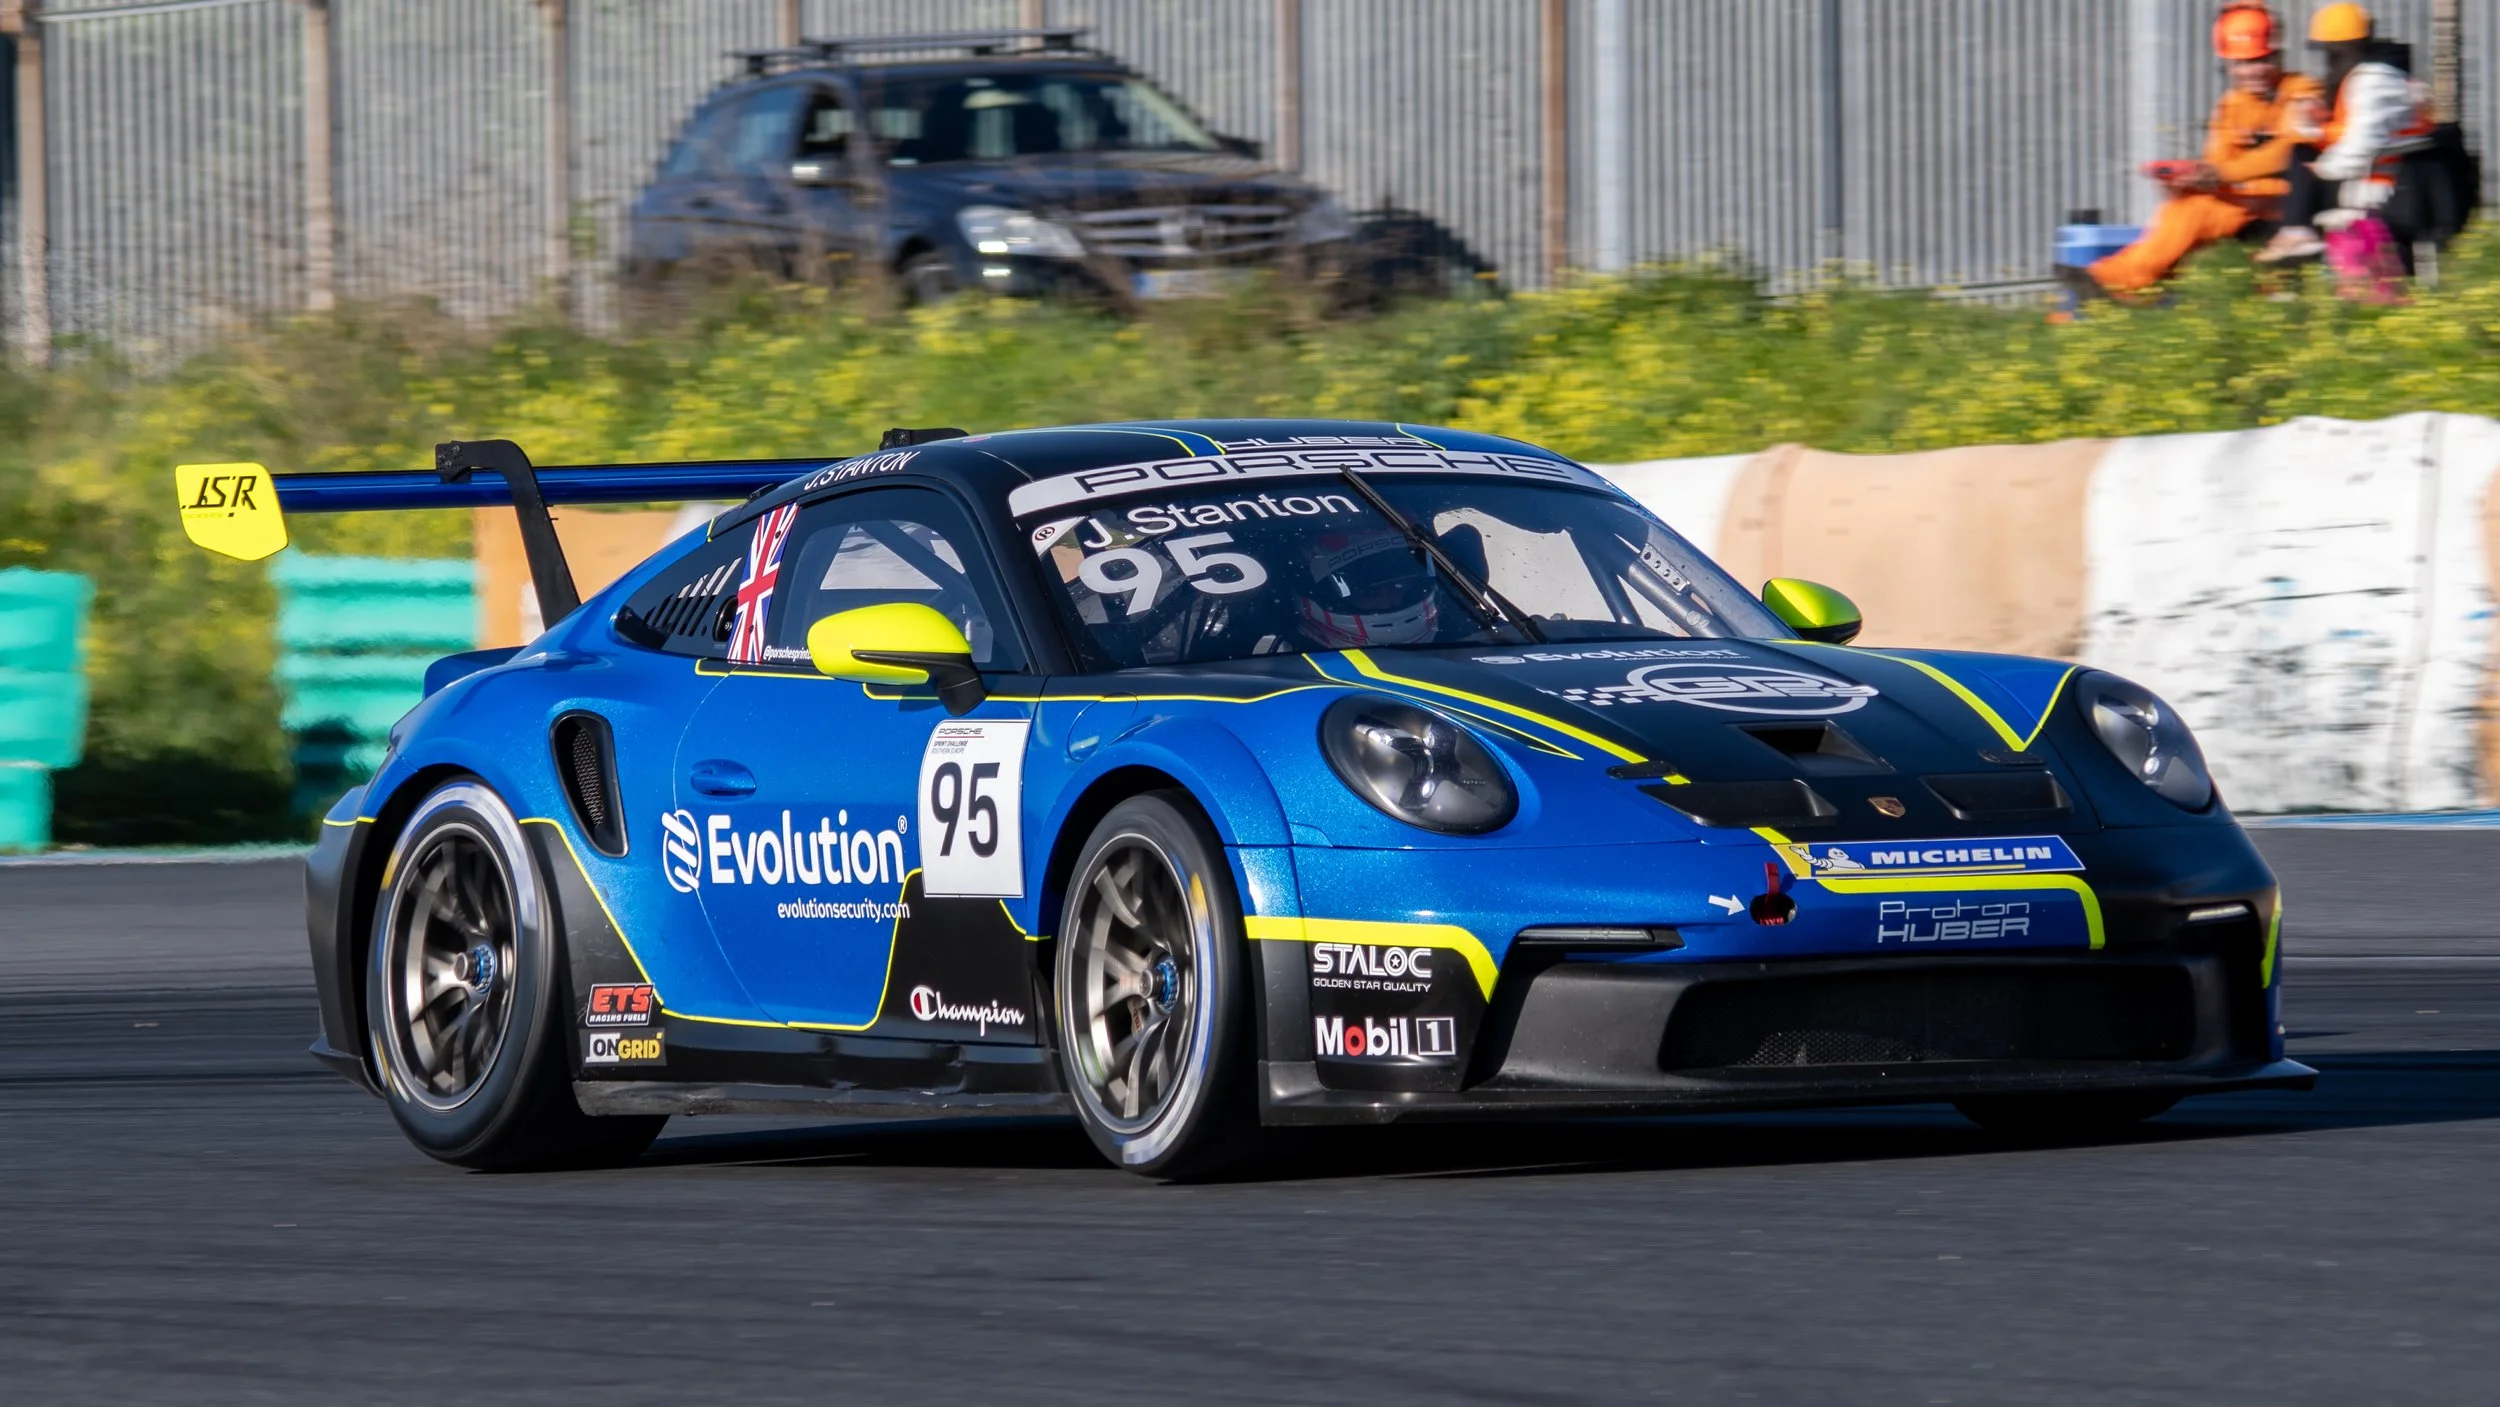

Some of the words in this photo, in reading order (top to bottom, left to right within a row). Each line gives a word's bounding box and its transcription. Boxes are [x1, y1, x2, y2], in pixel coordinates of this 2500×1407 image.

[1215, 436, 1431, 450] HUBER
[804, 451, 921, 490] J.STANTON
[1073, 452, 1573, 494] PORSCHE
[1078, 531, 1268, 615] 95
[938, 727, 983, 735] PORSCHE
[931, 761, 1000, 858] 95
[1871, 846, 2052, 865] MICHELIN
[777, 898, 910, 923] evolutionsecurity.com
[1880, 899, 2030, 920] Proton
[1877, 917, 2030, 943] HUBER
[1313, 942, 1433, 978] STALOC
[1313, 978, 1351, 989] GOLDEN
[1353, 980, 1381, 991] STAR
[1383, 982, 1432, 993] QUALITY
[592, 987, 651, 1013] ETS
[910, 985, 1025, 1037] Champion
[589, 1014, 622, 1023] RACING
[623, 1013, 647, 1022] FUELS
[1315, 1017, 1409, 1056] Mobil
